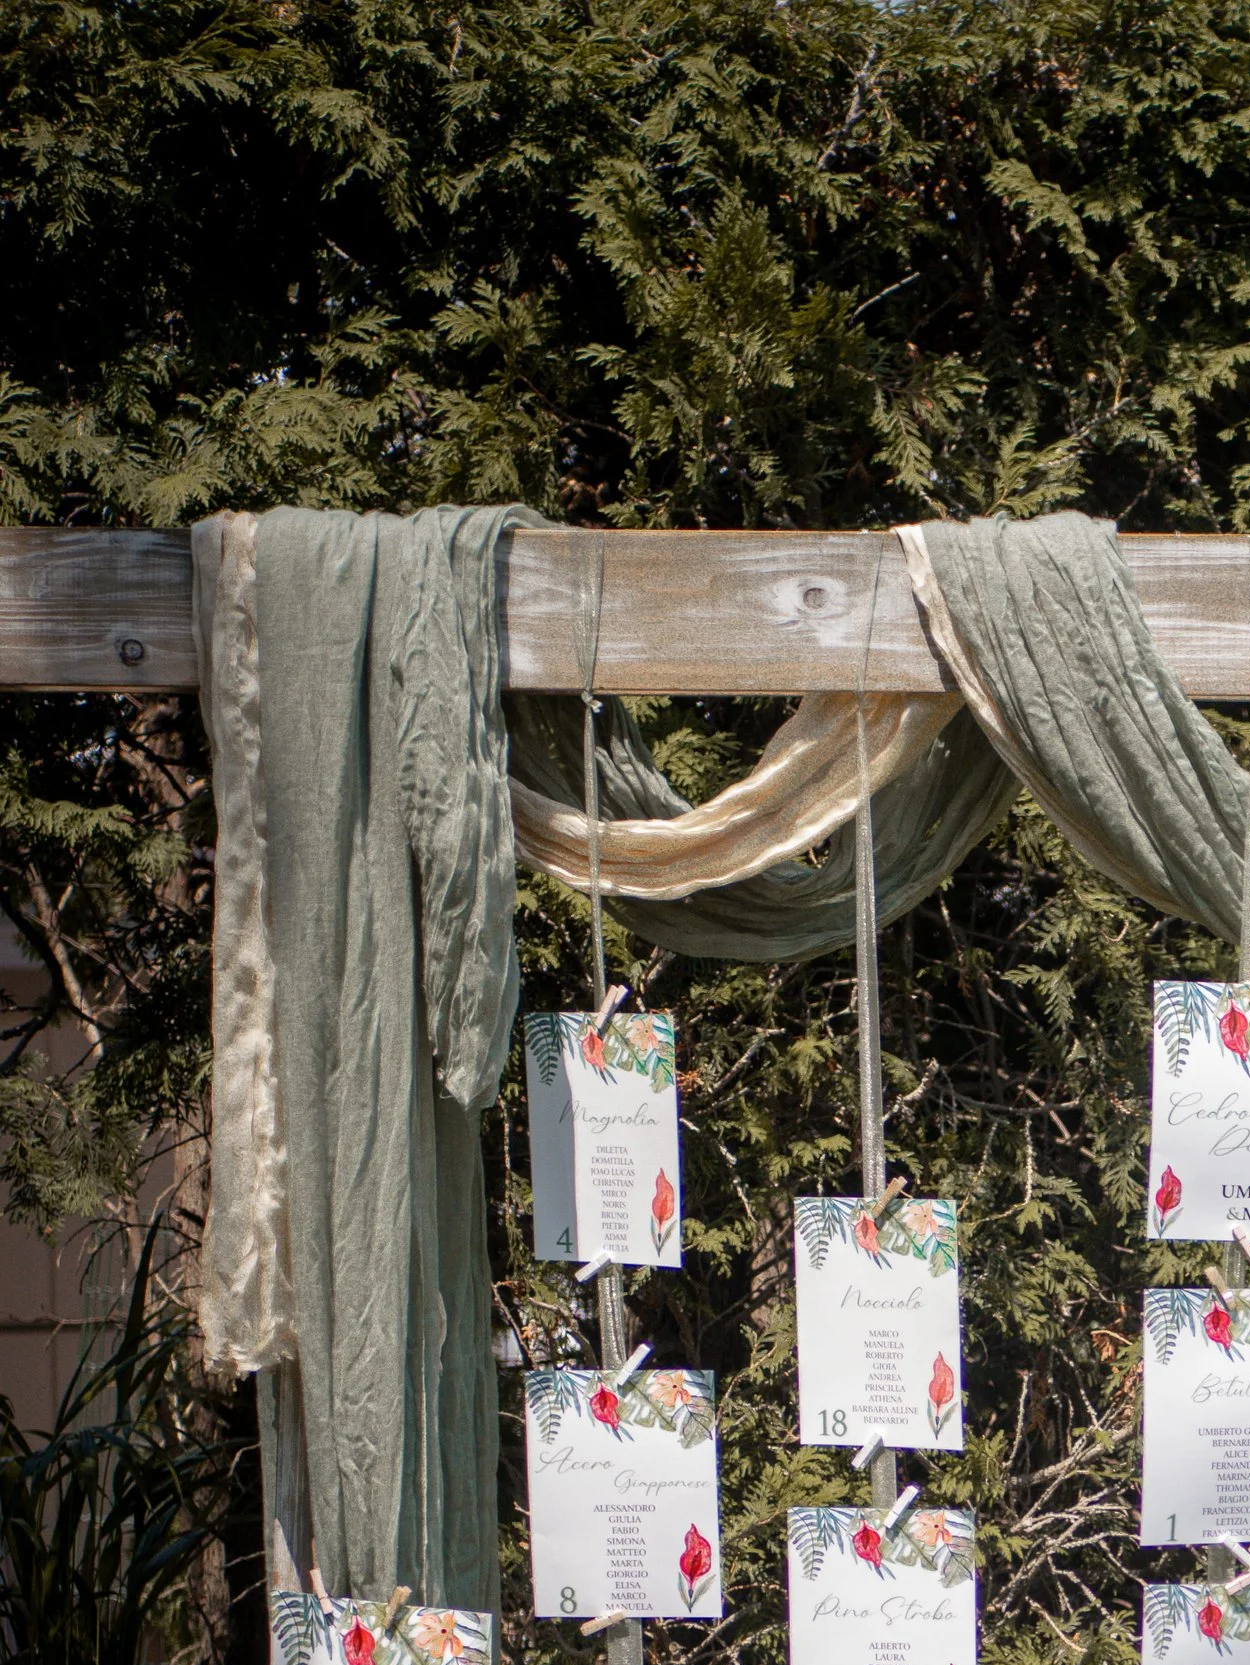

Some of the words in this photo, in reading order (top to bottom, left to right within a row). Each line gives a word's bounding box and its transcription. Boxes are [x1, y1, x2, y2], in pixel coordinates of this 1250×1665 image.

[559, 1101, 660, 1133] Magnolia
[592, 1157, 634, 1166] DOMITILLA
[593, 1178, 634, 1188] CHRISTIAN
[601, 1211, 629, 1220] BRUNO
[556, 1227, 573, 1253] 4
[841, 1284, 924, 1310] Nocciolo
[869, 1330, 899, 1338] MARCO
[864, 1340, 904, 1349] MANUELA
[866, 1351, 903, 1360] ROBERTO
[865, 1383, 905, 1392] PRISCILLA
[818, 1409, 847, 1437] 18
[1198, 1427, 1242, 1436] UMBERTO
[535, 1446, 615, 1474] Acero
[614, 1470, 711, 1496] Giapponese
[594, 1504, 655, 1512] ALESSANDRO
[1167, 1514, 1177, 1541] 1
[607, 1548, 646, 1556] MATTEO
[560, 1586, 577, 1614] 8
[812, 1593, 871, 1622] Pino
[880, 1596, 957, 1625] Strobo
[869, 1642, 910, 1650] ALBERTO
[875, 1653, 905, 1661] LAURA
